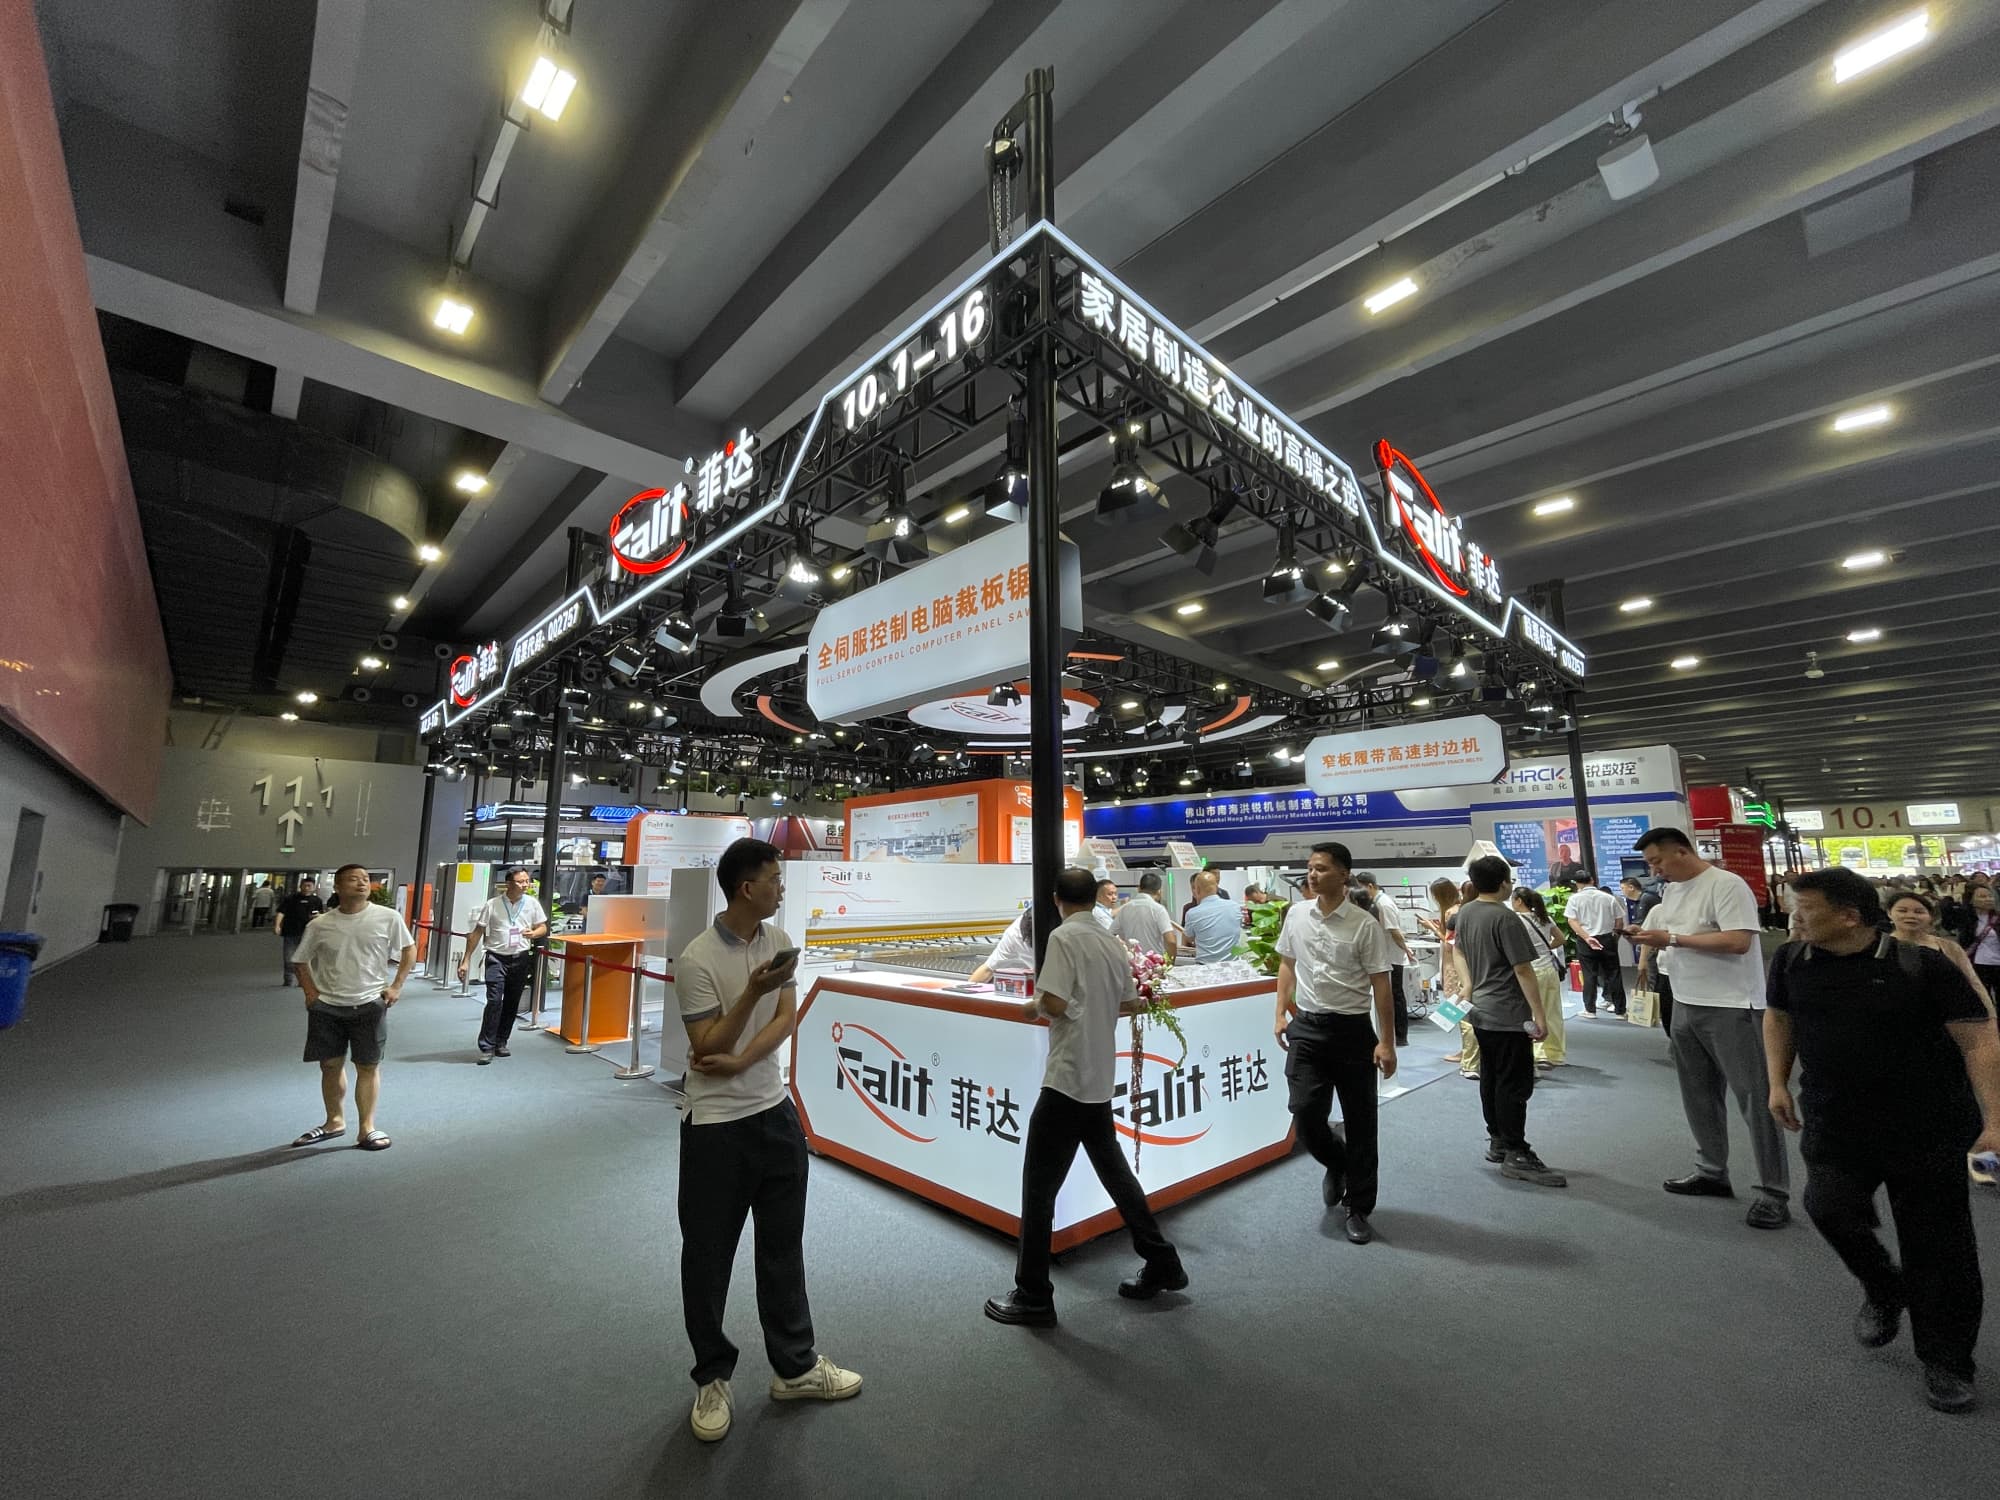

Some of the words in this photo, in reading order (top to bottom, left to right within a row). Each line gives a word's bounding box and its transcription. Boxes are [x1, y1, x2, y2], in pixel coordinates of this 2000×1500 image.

[843, 290, 985, 431] 10.1-16
[1081, 271, 1359, 517] 家居制造企业的高端之选
[696, 427, 756, 513] 菲达
[1388, 470, 1462, 574] Falit
[1466, 541, 1503, 603] 菲达
[547, 601, 579, 642] 002757
[817, 563, 1030, 671] 全伺服控制电脑裁板锯
[816, 674, 834, 688] FULL
[836, 664, 862, 680] SERVO
[865, 650, 905, 671] CONTROL
[909, 630, 962, 656] COMPUTER
[967, 616, 1003, 636] PANEL
[1322, 737, 1480, 769] 窄板履带高速封边机
[1511, 768, 1566, 784] HRCK
[1571, 761, 1638, 779] 锐数控
[256, 774, 333, 809] 11.1
[1493, 777, 1640, 794] 高品质自动化备制造商
[1255, 812, 1289, 821] Machinery
[1290, 809, 1341, 819] Manufacturing
[1830, 806, 1900, 830] 10.1
[822, 869, 852, 882] Falit
[856, 869, 872, 881] 菲达
[837, 1046, 933, 1118] Falit
[1219, 1049, 1269, 1103] 菲达
[951, 1076, 1021, 1145] 菲达
